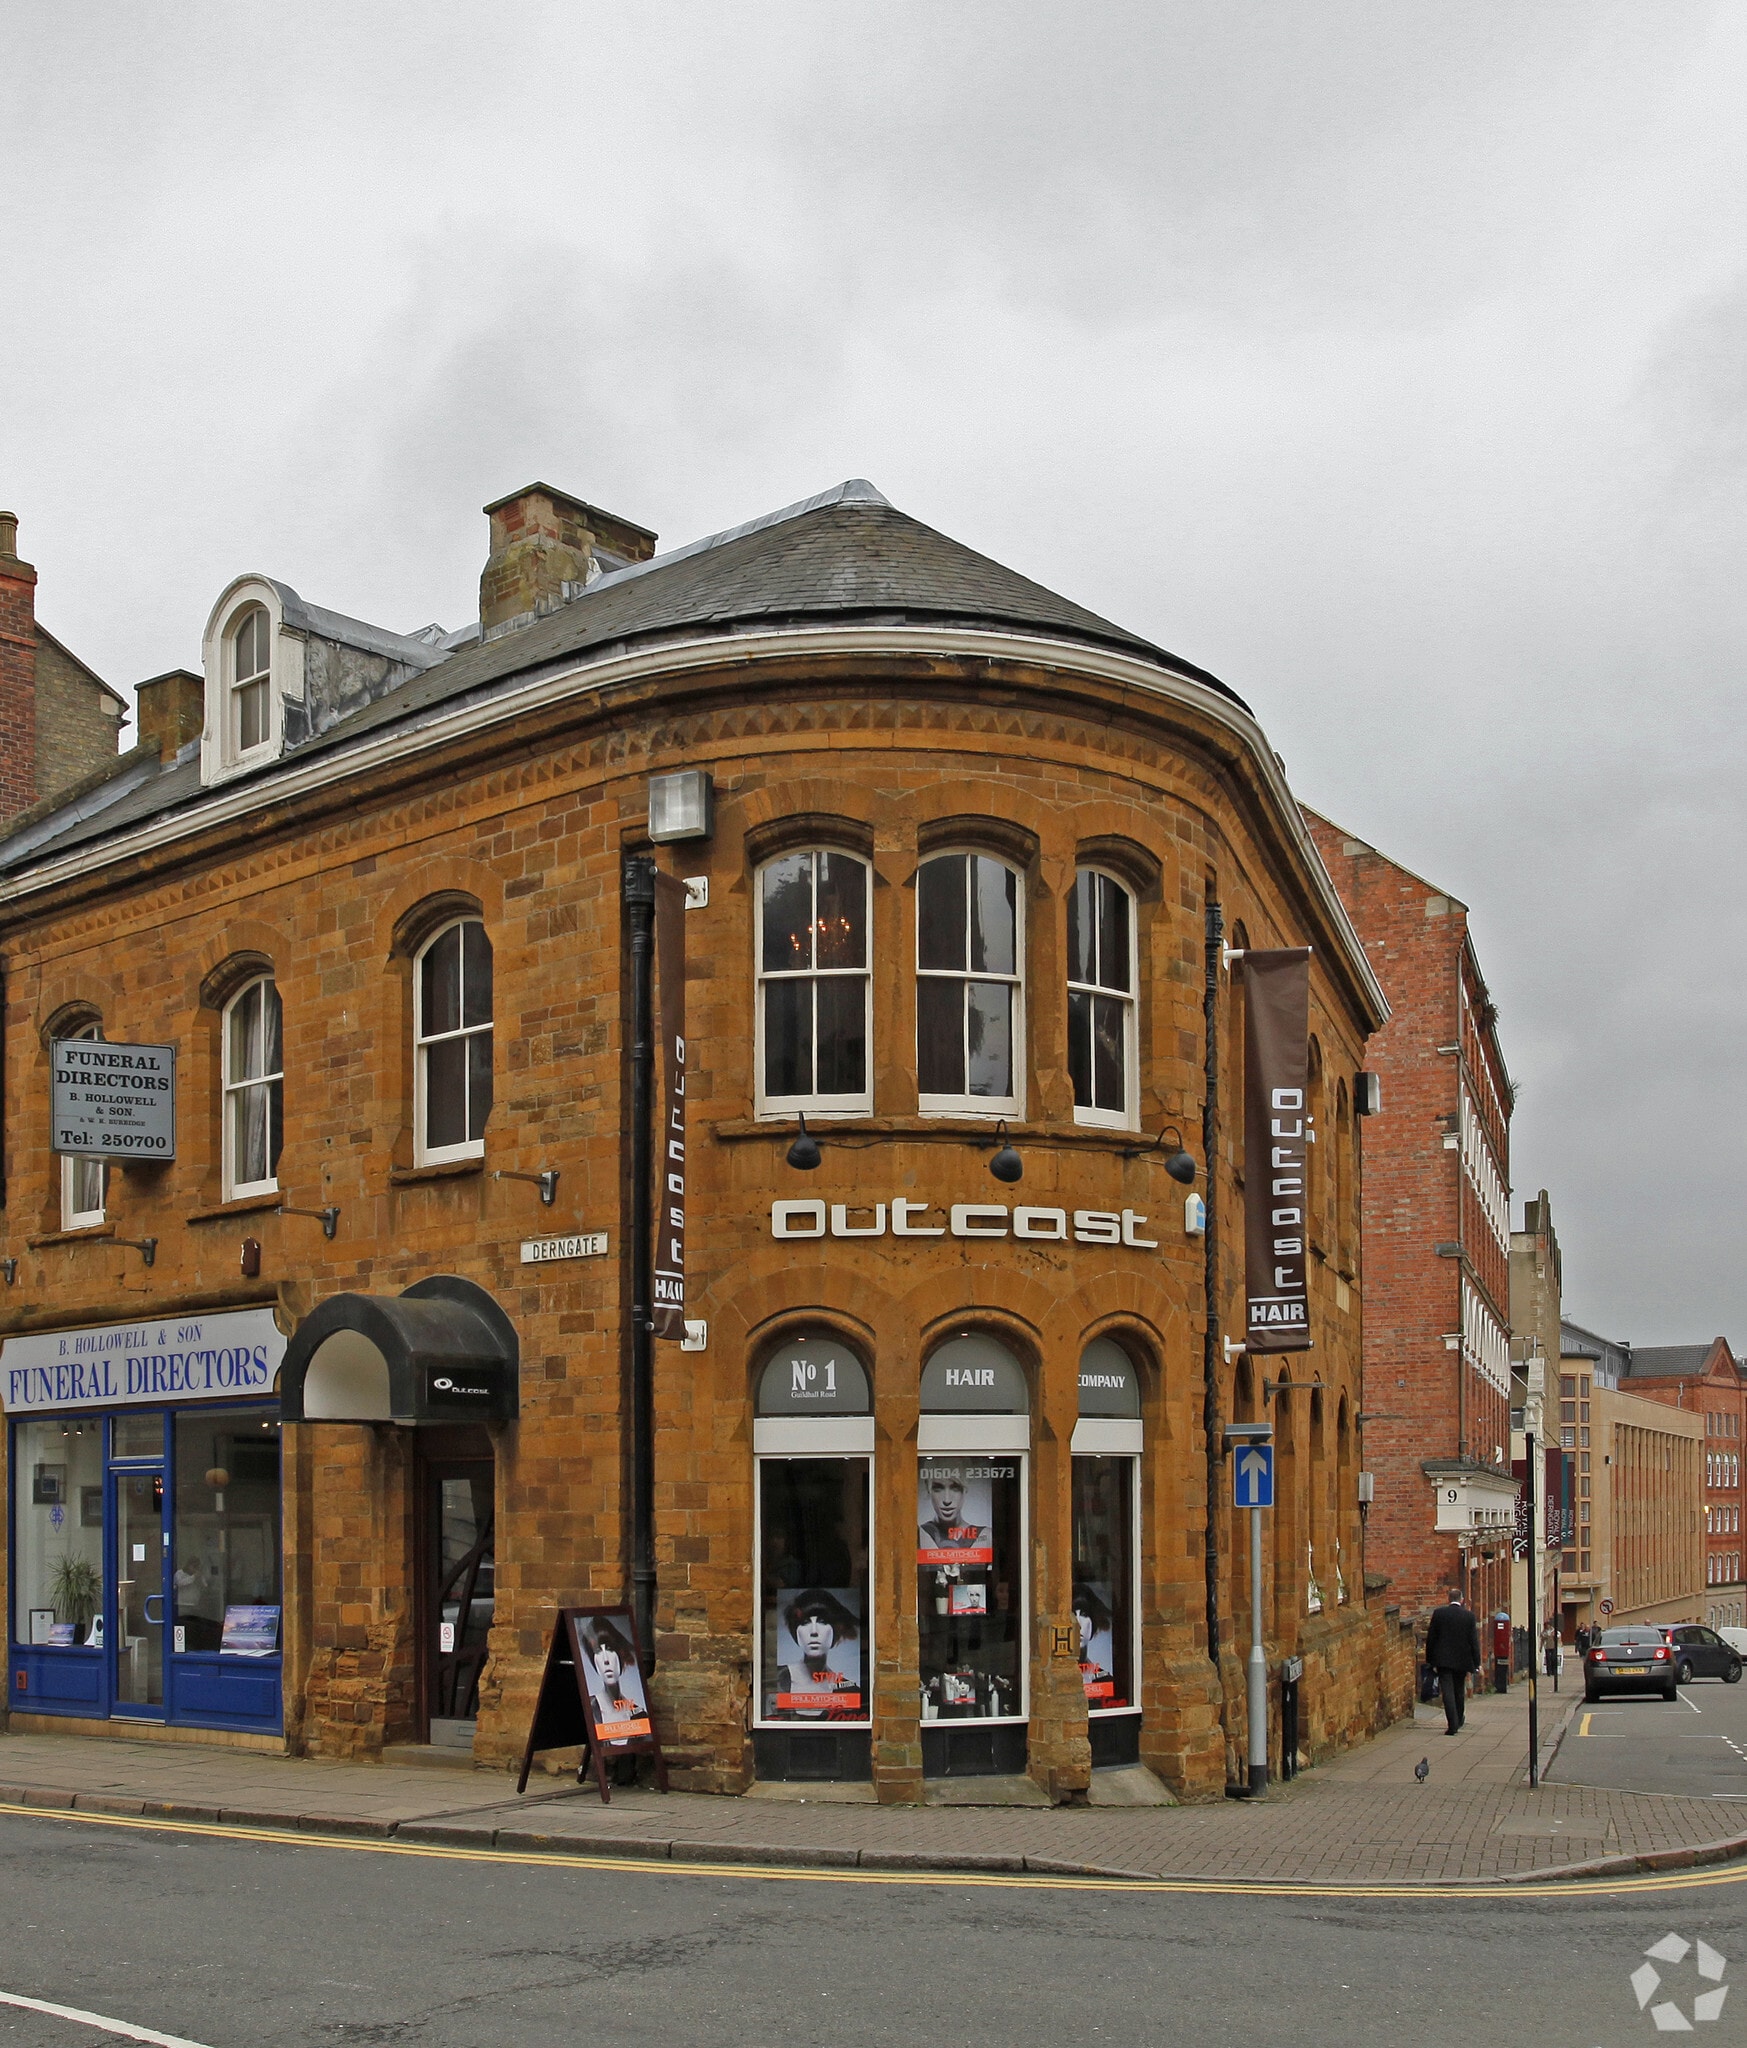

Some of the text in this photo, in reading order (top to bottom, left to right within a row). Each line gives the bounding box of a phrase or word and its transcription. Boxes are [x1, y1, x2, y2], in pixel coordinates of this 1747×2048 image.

[65, 1051, 160, 1070] FUNERAL
[56, 1070, 169, 1091] DIRECTORS
[69, 1092, 157, 1106] B. HOLLOWELL
[95, 1106, 136, 1117] & SON.
[60, 1130, 167, 1148] Tel: 250700
[533, 1237, 598, 1260] DERNGATE
[655, 1279, 684, 1301] HAI
[1251, 1303, 1305, 1323] HAIR
[59, 1324, 203, 1356] B. HOLLOWELL & SON
[9, 1346, 268, 1404] FUNERAL DIRECTORS
[824, 1359, 837, 1390] 1
[945, 1368, 995, 1386] HAIR
[920, 1467, 1015, 1479] 01604 233673
[1447, 1489, 1458, 1504] 9
[948, 1527, 977, 1540] STYLE
[1547, 1535, 1560, 1547] &
[812, 1671, 844, 1684] STYLE
